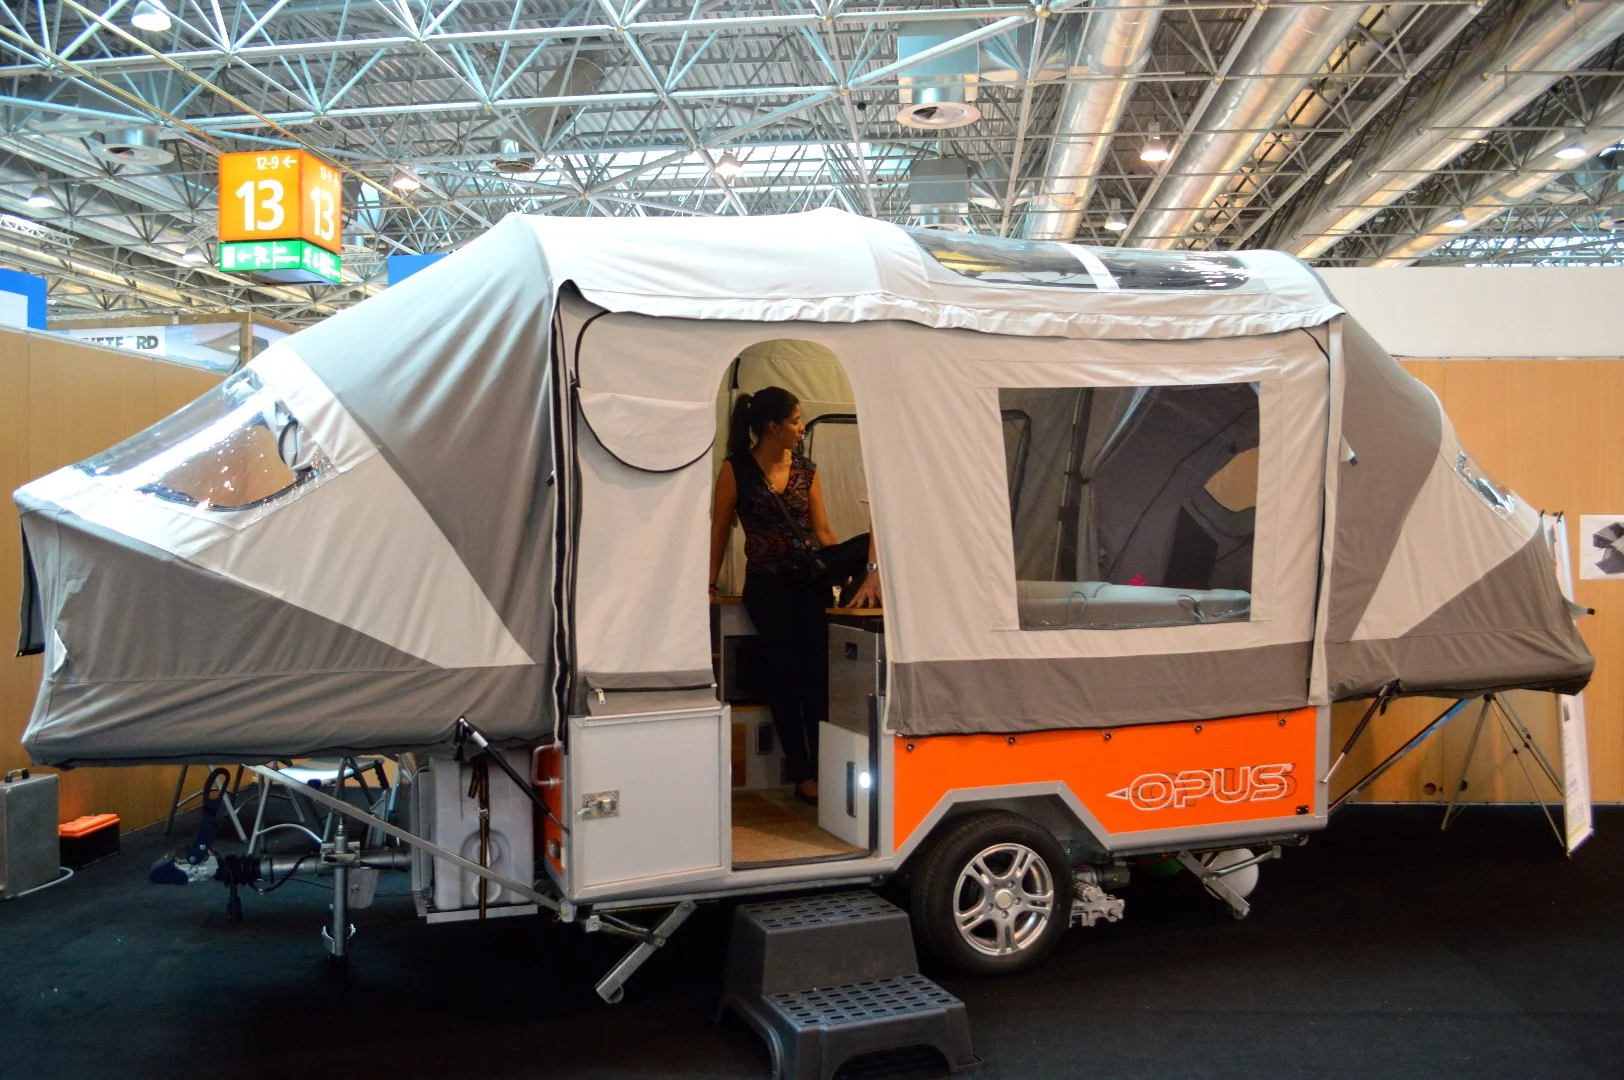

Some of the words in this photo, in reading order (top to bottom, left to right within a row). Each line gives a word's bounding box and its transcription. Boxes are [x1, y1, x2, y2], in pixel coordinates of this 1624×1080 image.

[256, 156, 280, 170] 12-9
[235, 179, 285, 231] 13
[310, 186, 335, 241] 13
[1129, 764, 1293, 811] OPUS
